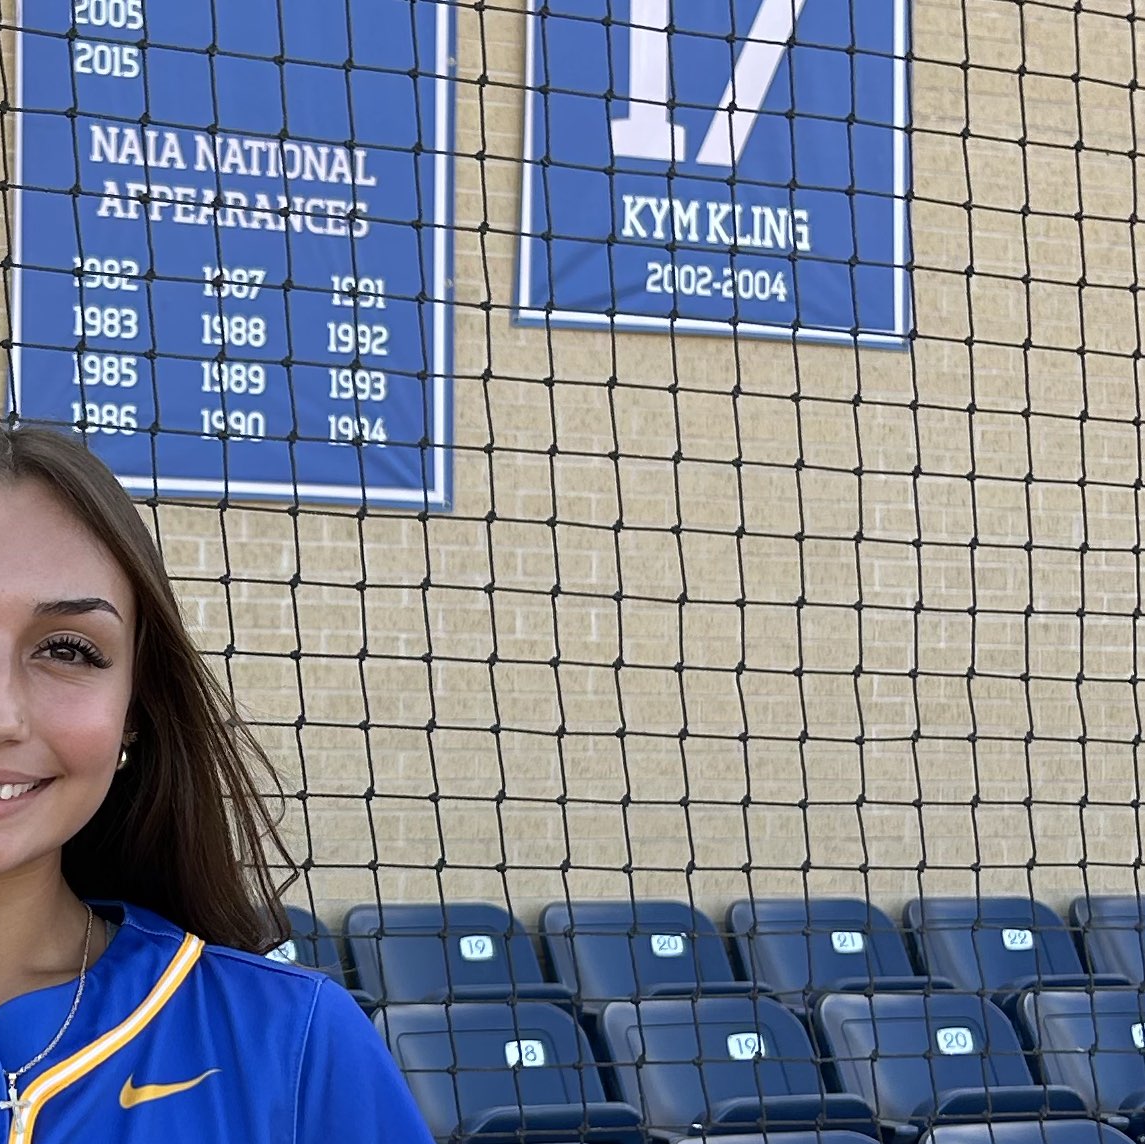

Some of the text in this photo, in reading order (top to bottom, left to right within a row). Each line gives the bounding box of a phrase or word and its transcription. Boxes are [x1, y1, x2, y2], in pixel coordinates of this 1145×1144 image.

[70, 0, 144, 30] 2005
[74, 42, 140, 78] 2015
[89, 125, 376, 186] NAIA NATIONAL
[96, 180, 370, 238] APPEARANCES
[621, 194, 811, 251] KYM KLING
[73, 257, 138, 291] 1982
[202, 266, 266, 299] 1987
[645, 261, 788, 302] 2002-2004
[331, 275, 386, 309] 1991
[73, 305, 138, 339] 1983
[201, 314, 267, 347] 1988
[327, 321, 388, 356] 1992
[72, 353, 137, 387] 1985
[201, 361, 265, 395] 1989
[329, 368, 386, 401] 1993
[71, 402, 137, 435] 1986
[200, 408, 266, 441] 1990
[467, 939, 486, 955] 19
[657, 935, 678, 951] 20
[837, 932, 855, 948] 21
[1008, 932, 1027, 945] 22
[515, 1044, 537, 1062] 8
[736, 1037, 756, 1055] 19
[943, 1031, 967, 1048] 20
